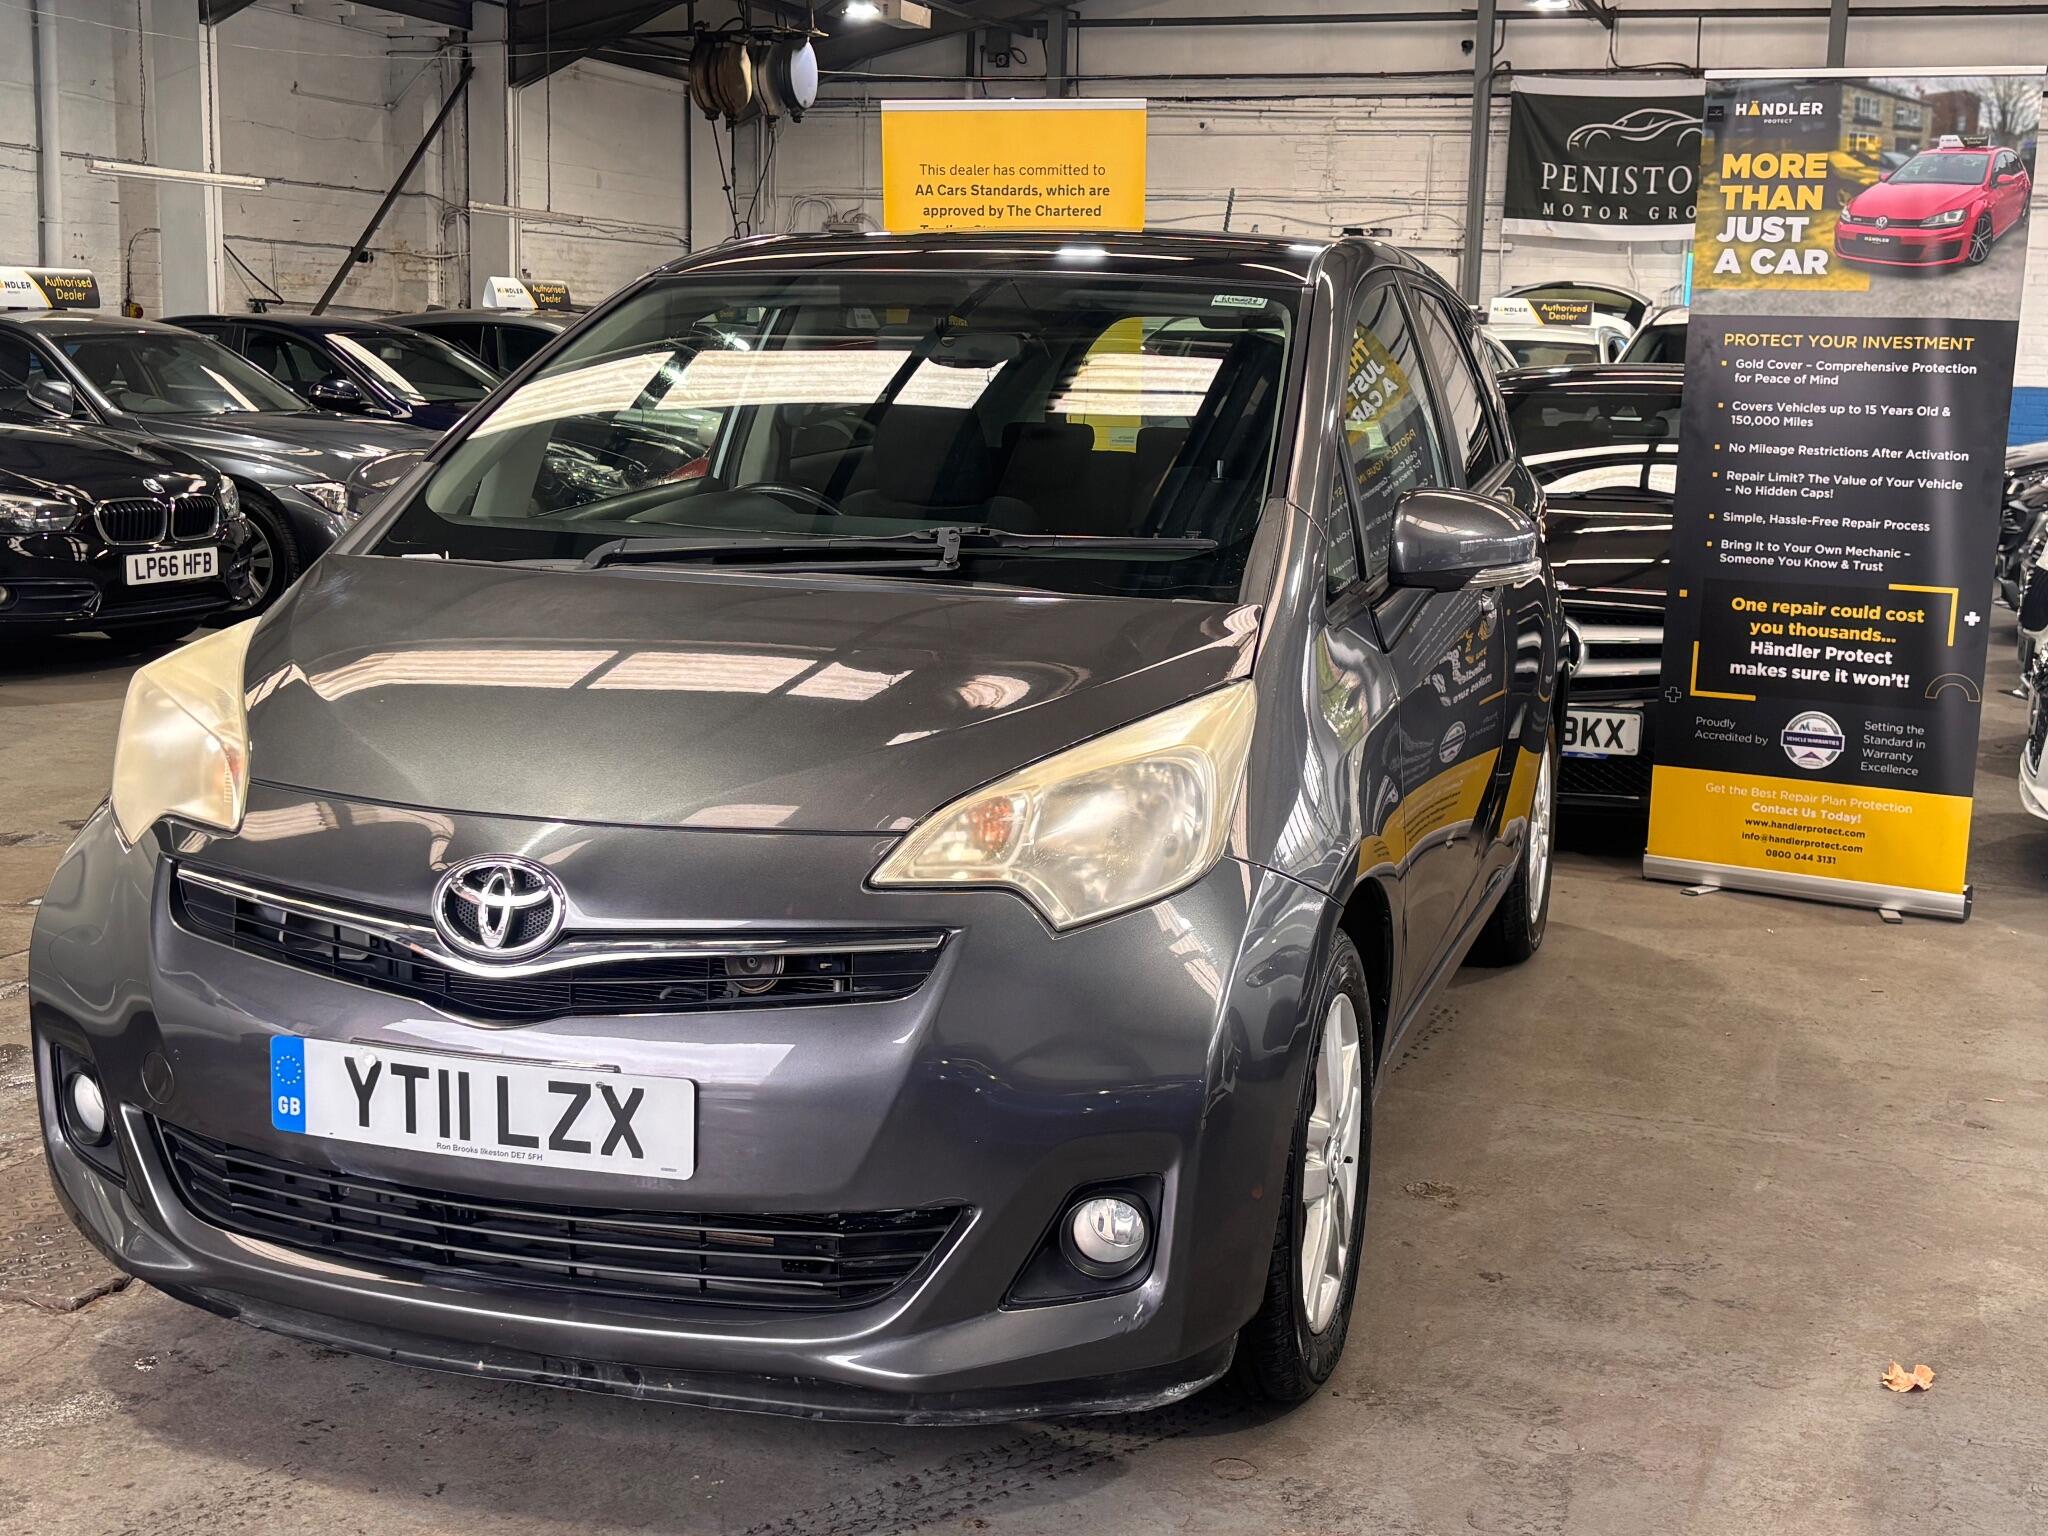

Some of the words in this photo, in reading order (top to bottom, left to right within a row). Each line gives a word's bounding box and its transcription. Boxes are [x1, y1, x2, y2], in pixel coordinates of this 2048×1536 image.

[920, 164, 946, 176] This
[950, 164, 989, 176] dealer
[993, 164, 1015, 176] has
[1019, 164, 1089, 176] committed
[1093, 164, 1106, 176] to
[1722, 153, 1829, 180] MORE
[1541, 162, 1700, 195] PENISTO
[915, 185, 934, 196] AA
[937, 185, 967, 196] Cars
[971, 185, 1042, 198] Standards,
[1046, 185, 1085, 196] which
[1089, 187, 1110, 196] are
[1720, 185, 1824, 211] THAN
[923, 205, 985, 219] approved
[989, 205, 1004, 219] by
[1007, 205, 1031, 217] The
[1035, 205, 1102, 217] Chartered
[1543, 202, 1629, 220] MOTOR
[1649, 205, 1697, 220] GRO
[1716, 216, 1810, 243] JUST
[1713, 248, 1742, 274] A
[1750, 248, 1829, 275] CAR
[45, 275, 93, 289] Authorised
[533, 284, 566, 294] Authorised
[56, 289, 86, 301] Dealer
[540, 294, 561, 303] Dealer
[1541, 304, 1588, 313] Authorised
[1549, 312, 1578, 321] Dealer
[1724, 333, 1803, 349] PROTECT
[1808, 335, 1858, 349] YOUR
[1862, 336, 1976, 351] INVESTMENT
[1735, 359, 1764, 370] Gold
[1767, 360, 1802, 371] Cover
[1816, 361, 1909, 374] Comprehensive
[1912, 363, 1977, 375] Protection
[1735, 373, 1752, 384] for
[1755, 374, 1791, 385] Peace
[1794, 374, 1807, 385] of
[1810, 374, 1839, 386] Mind
[1732, 401, 1774, 412] Covers
[1777, 402, 1826, 414] Vehicles
[1829, 405, 1846, 416] up
[1849, 404, 1861, 415] to
[1865, 405, 1877, 415] 15
[1880, 405, 1914, 417] Years
[1917, 406, 1939, 417] Old
[1941, 407, 1951, 417] &
[1731, 415, 1781, 428] 150,000
[1783, 416, 1814, 428] Miles
[1729, 443, 1746, 453] No
[1749, 444, 1795, 456] Mileage
[1798, 446, 1869, 458] Restrictions
[1872, 448, 1902, 459] After
[1906, 449, 1970, 462] Activation
[1727, 471, 1765, 483] Repair
[1768, 472, 1805, 483] Limit?
[1808, 474, 1830, 485] The
[1834, 475, 1867, 487] Value
[1870, 476, 1883, 487] of
[1886, 477, 1914, 488] Your
[1918, 478, 1963, 490] Vehicle
[1735, 485, 1752, 496] No
[1755, 486, 1798, 497] Hidden
[1801, 488, 1834, 500] Caps!
[1723, 512, 1767, 525] Simple,
[1770, 514, 1839, 527] Hassle-Free
[1842, 518, 1881, 530] Repair
[1884, 520, 1930, 532] Process
[1721, 540, 1752, 551] Bring
[1756, 542, 1764, 551] It
[1767, 542, 1781, 552] to
[1783, 542, 1812, 554] Your
[1815, 545, 1843, 556] Own
[1846, 546, 1901, 560] Mechanic
[135, 556, 178, 580] LP66
[184, 552, 212, 575] HFB
[1720, 553, 1774, 567] Someone
[1778, 556, 1801, 567] You
[1805, 558, 1838, 570] Know
[1841, 560, 1850, 570] &
[1853, 561, 1884, 572] Trust
[1731, 598, 1768, 613] One
[1772, 602, 1826, 617] repair
[1830, 606, 1881, 620] could
[1885, 609, 1925, 624] cost
[1750, 622, 1783, 636] you
[1789, 623, 1897, 643] thousands...
[1750, 641, 1820, 660] Händler
[1825, 646, 1893, 665] Protect
[1729, 662, 1787, 679] makes
[1792, 668, 1831, 682] sure
[1835, 668, 1849, 683] it
[1853, 672, 1910, 689] won’t!
[1696, 716, 1736, 730] Proudly
[1864, 720, 1904, 736] Setting
[1907, 723, 1925, 736] the
[1695, 730, 1752, 744] Accredited
[1755, 735, 1769, 747] by
[1863, 734, 1913, 749] Standard
[1916, 739, 1926, 749] in
[1862, 748, 1913, 763] Warranty
[1860, 762, 1919, 776] Excellence
[1706, 783, 1726, 794] Get
[1729, 785, 1748, 797] the
[1752, 788, 1777, 800] Best
[1780, 791, 1819, 804] Repair
[1821, 795, 1847, 807] Plan
[1850, 799, 1913, 814] Protection
[1752, 803, 1798, 817] Contact
[1802, 806, 1817, 818] Us
[1821, 809, 1862, 825] Today!
[1745, 818, 1866, 839] www.handlerprotect.com
[1742, 832, 1863, 853] info@handlerprotect.com
[1765, 849, 1791, 859] 0800
[1794, 852, 1814, 862] 044
[1817, 855, 1836, 865] 3131
[278, 1096, 301, 1116] GB
[344, 1056, 472, 1142] YT11
[496, 1075, 645, 1160] LZX
[437, 1143, 452, 1152] Ron
[452, 1144, 479, 1154] Brooks
[511, 1151, 527, 1160] DE7
[528, 1153, 543, 1162] 5FH
